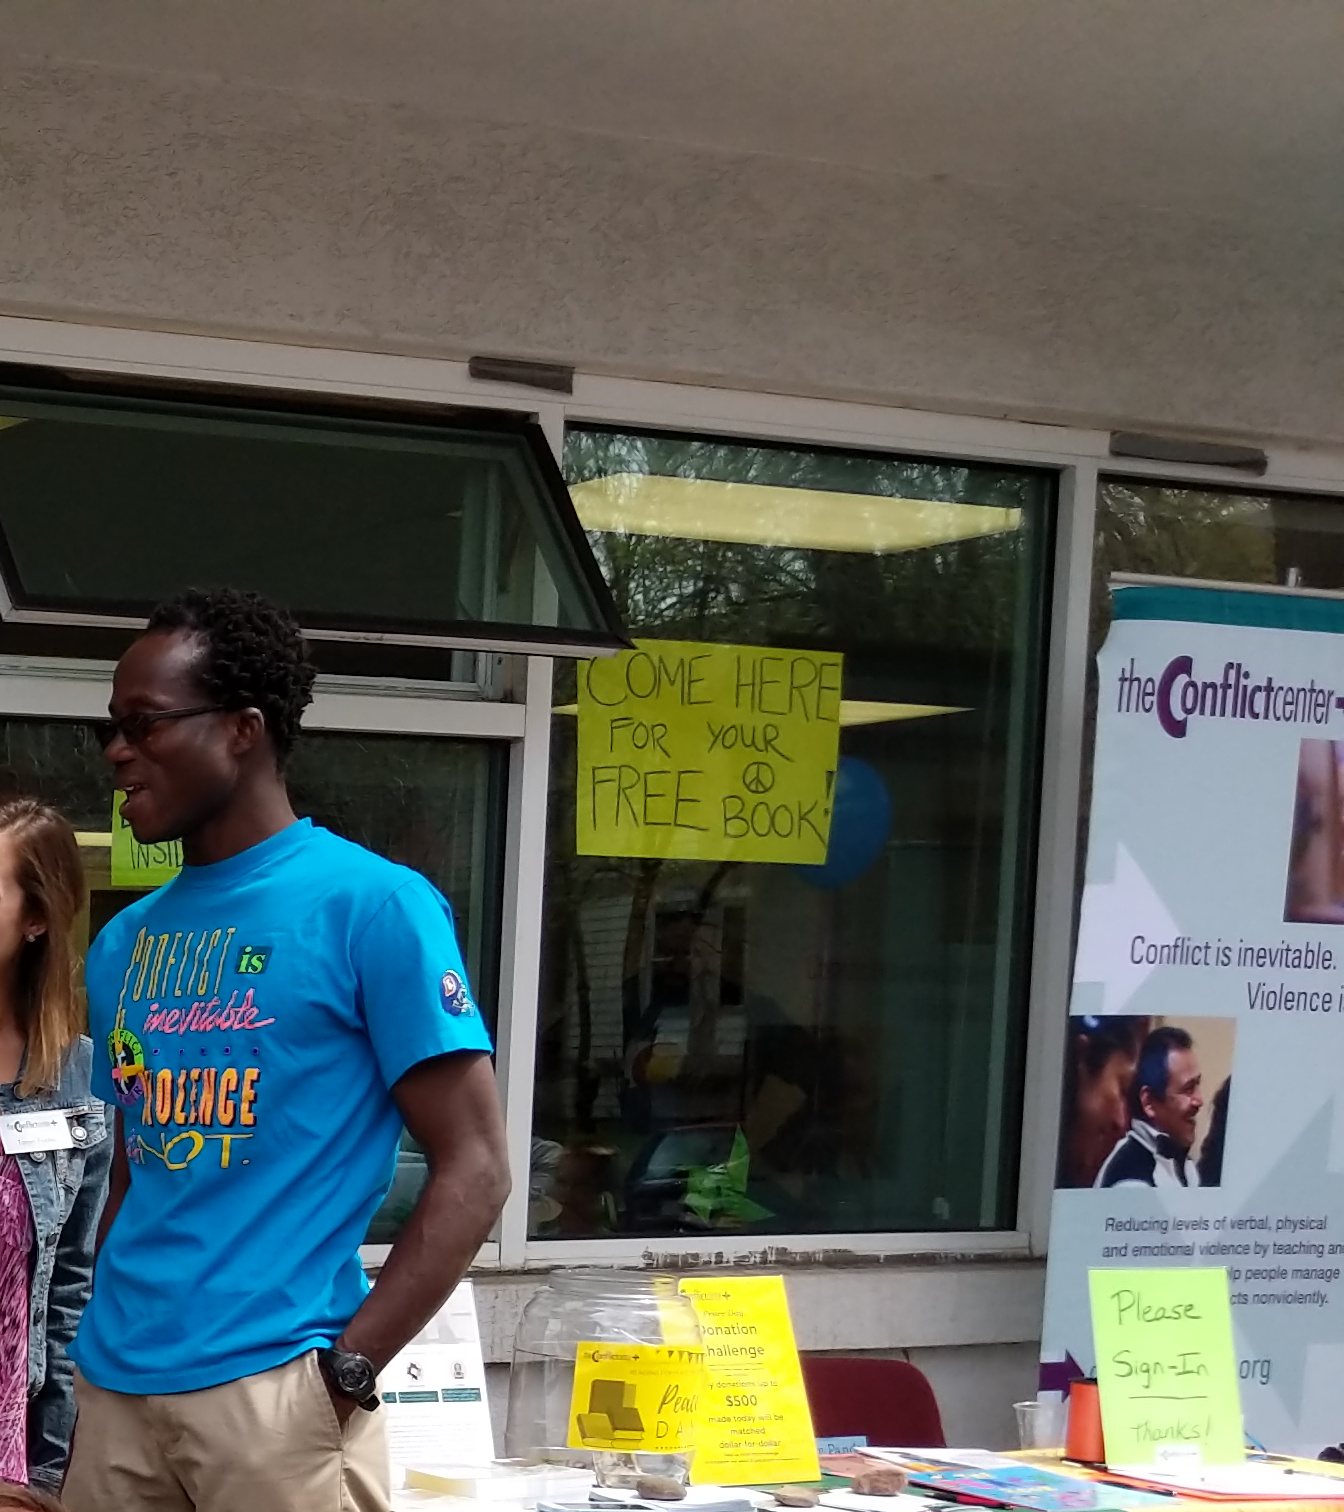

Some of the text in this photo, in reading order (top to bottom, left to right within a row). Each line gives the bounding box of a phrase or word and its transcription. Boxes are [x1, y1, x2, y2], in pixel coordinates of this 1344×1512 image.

[587, 652, 839, 722] COME HERE
[610, 717, 794, 763] FOR YOUR
[592, 765, 709, 831] FREE
[237, 946, 266, 973] is
[1130, 935, 1337, 973] Conflict is inevitable.
[1247, 982, 1332, 1013] Violence
[1104, 1216, 1327, 1234] Reducing levels of verbal, physical
[1102, 1243, 1128, 1258] and
[1132, 1242, 1195, 1258] emotional
[1199, 1241, 1250, 1256] violence
[1254, 1241, 1268, 1258] by
[1272, 1240, 1324, 1258] teaching
[1245, 1265, 1288, 1282] people
[1291, 1267, 1340, 1283] manage
[1111, 1289, 1203, 1326] Please
[1253, 1290, 1329, 1307] nonviolently.
[705, 1345, 765, 1359] hallenge
[1112, 1350, 1209, 1389] Sign-In
[725, 1394, 758, 1407] $500
